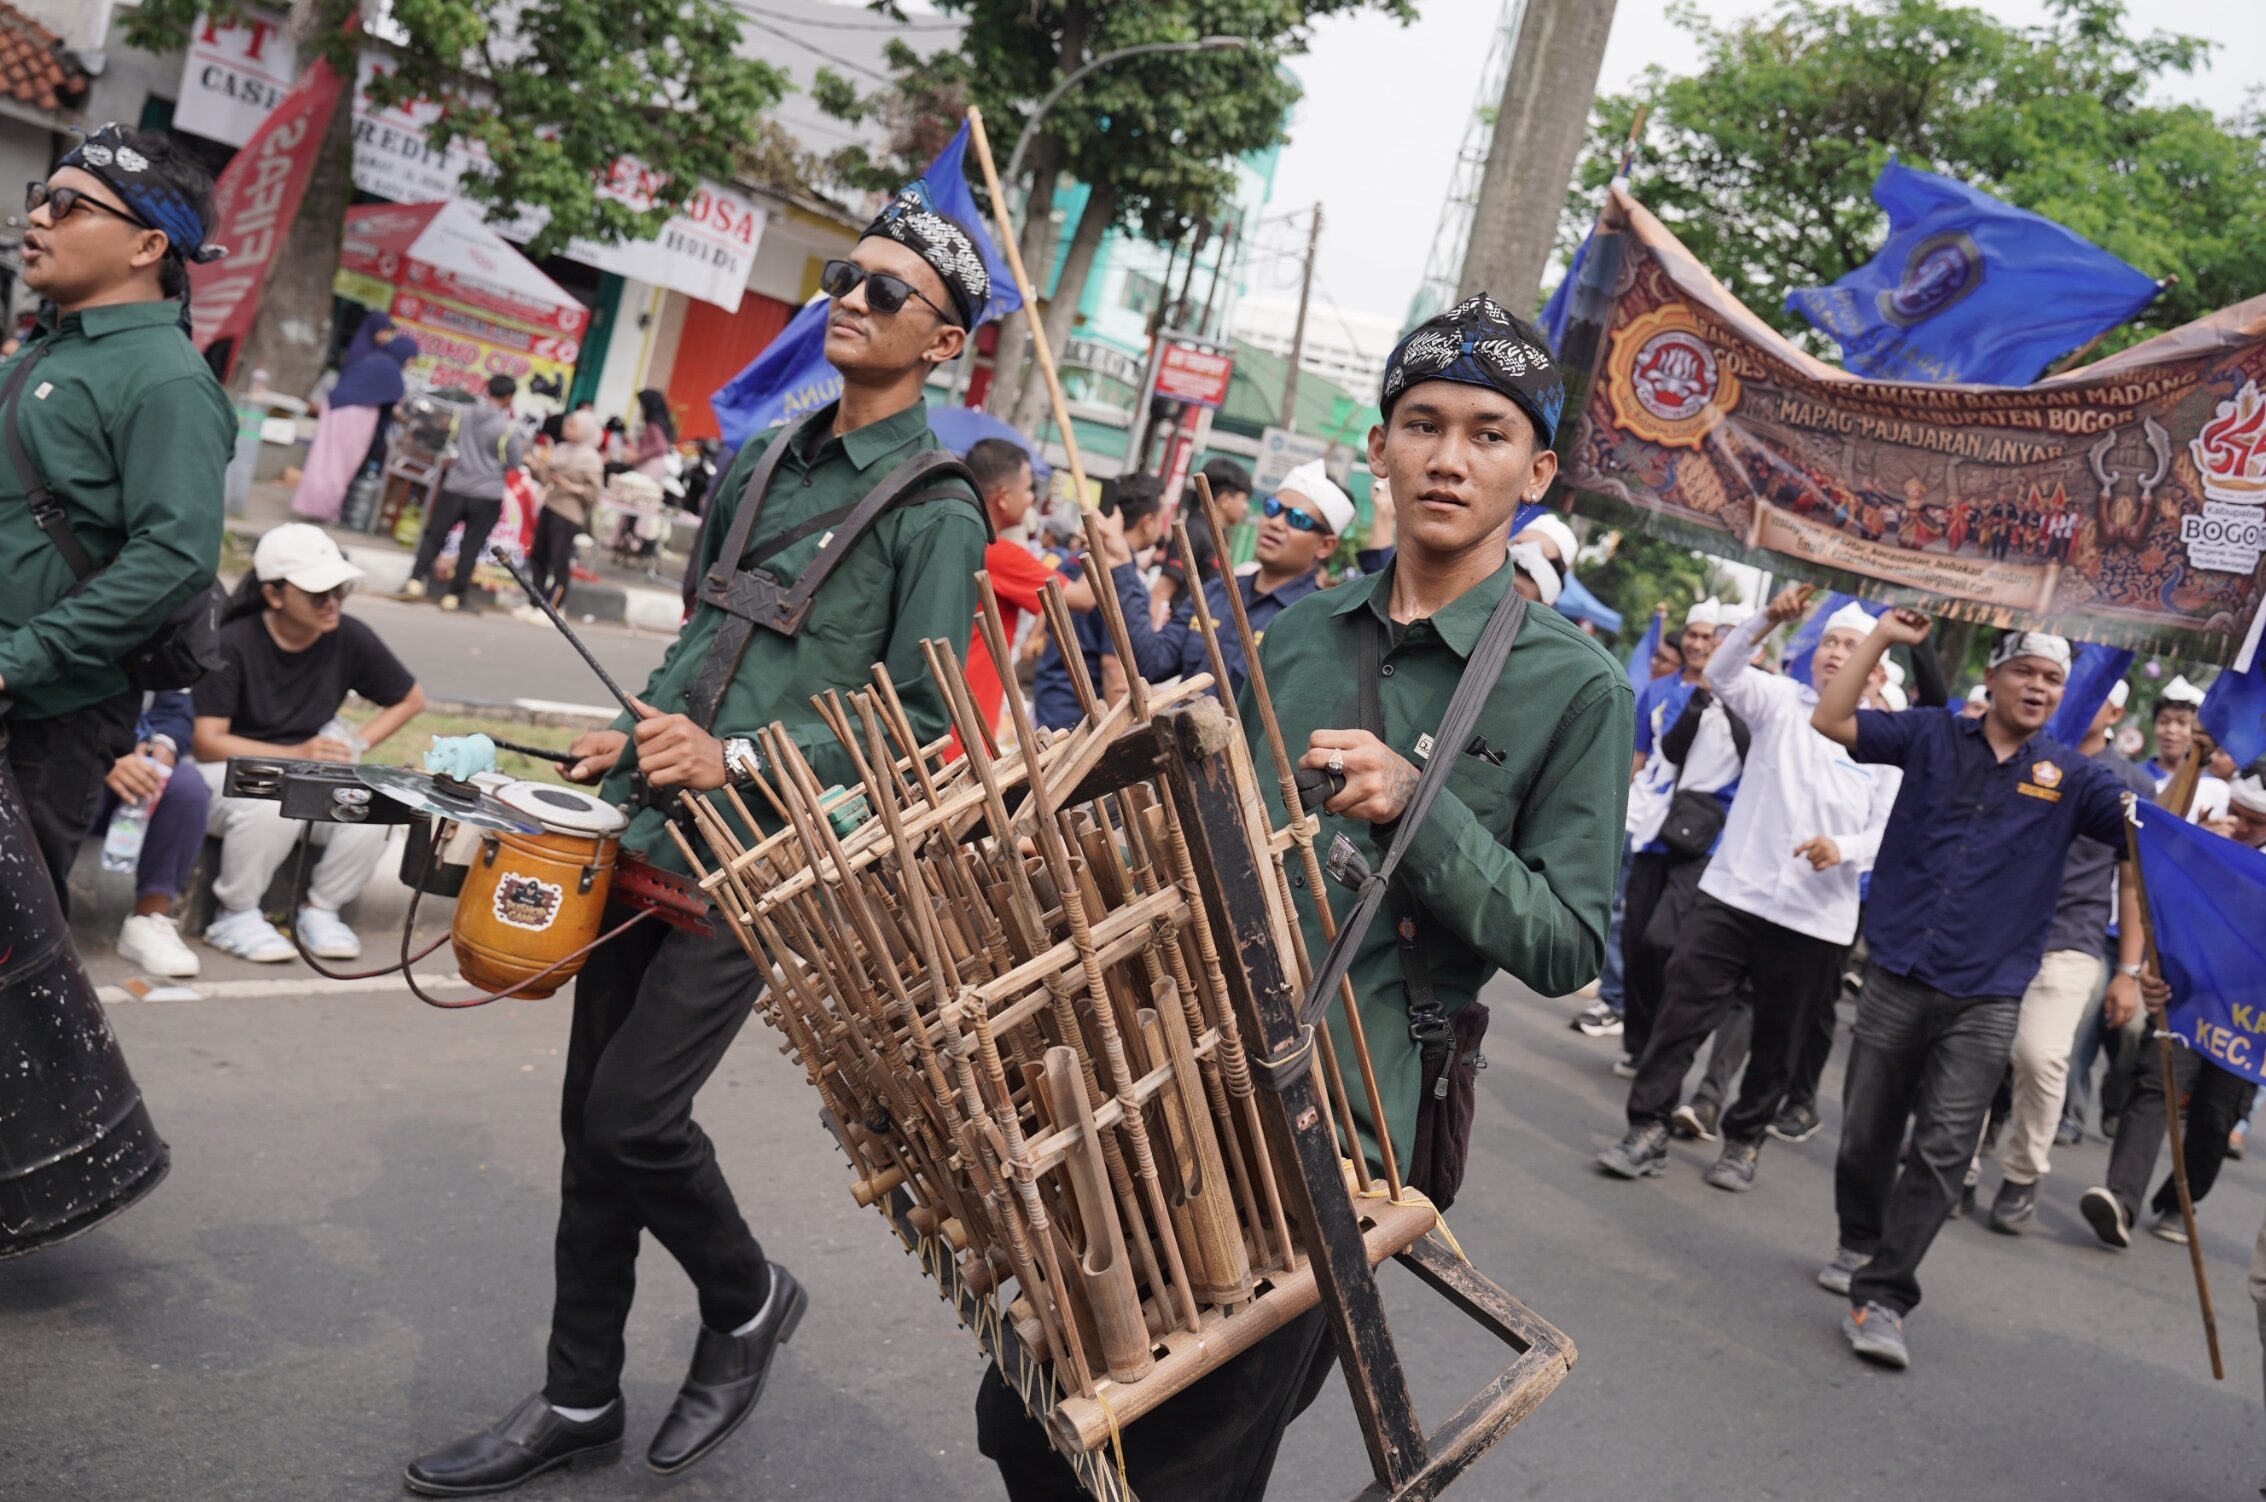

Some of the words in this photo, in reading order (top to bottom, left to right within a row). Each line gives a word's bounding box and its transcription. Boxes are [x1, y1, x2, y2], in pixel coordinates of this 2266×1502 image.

[352, 118, 456, 173] REDIT
[2085, 370, 2197, 406] MADANG
[2049, 408, 2135, 433] BOGOR
[2186, 519, 2266, 546] BOGO
[2195, 1017, 2252, 1071] KEC.
